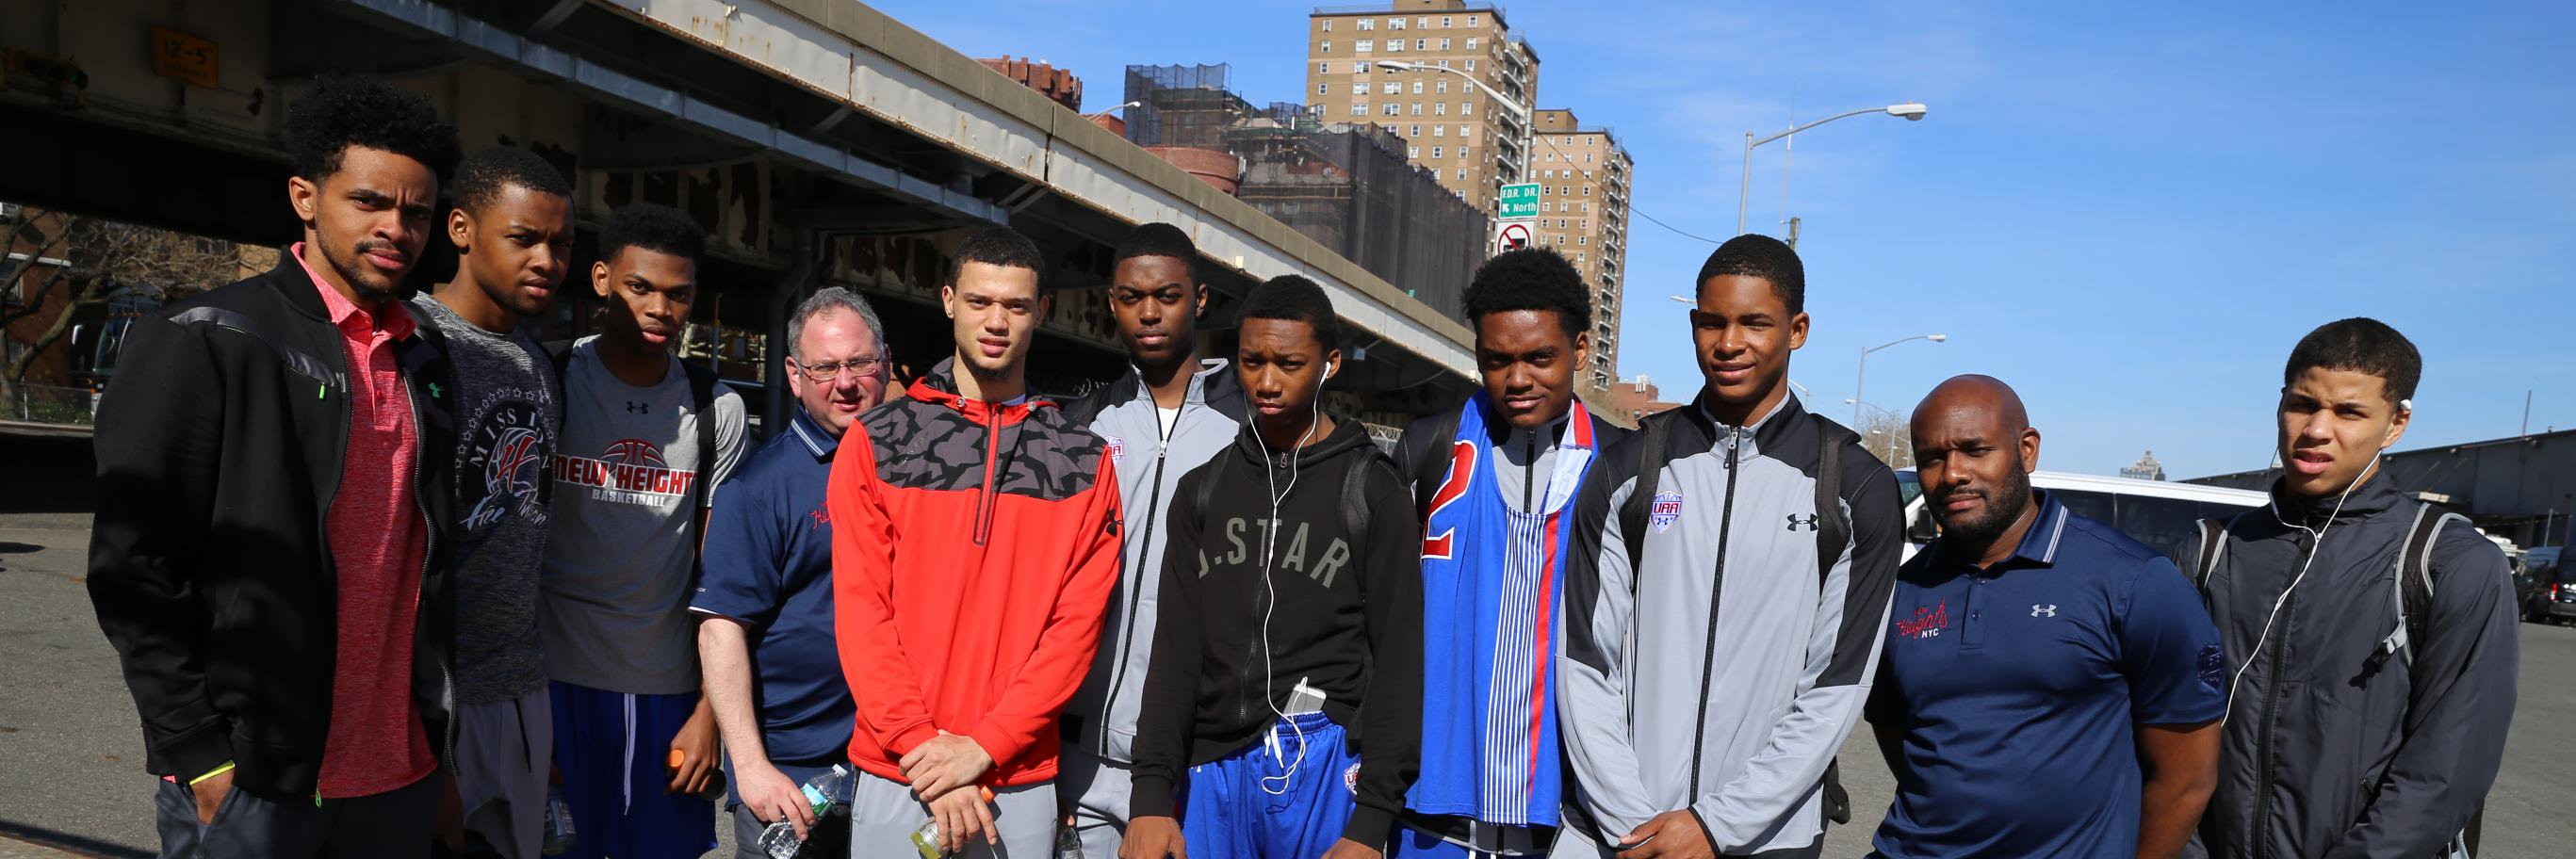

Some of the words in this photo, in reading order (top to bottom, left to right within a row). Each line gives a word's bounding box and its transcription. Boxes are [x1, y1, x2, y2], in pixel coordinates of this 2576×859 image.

[1524, 187, 1537, 197] DR.
[1512, 202, 1537, 213] North
[613, 463, 696, 496] HEIGHT
[592, 488, 665, 508] BASKETBALL
[1653, 501, 1679, 514] UAA
[1921, 628, 1939, 639] NYC
